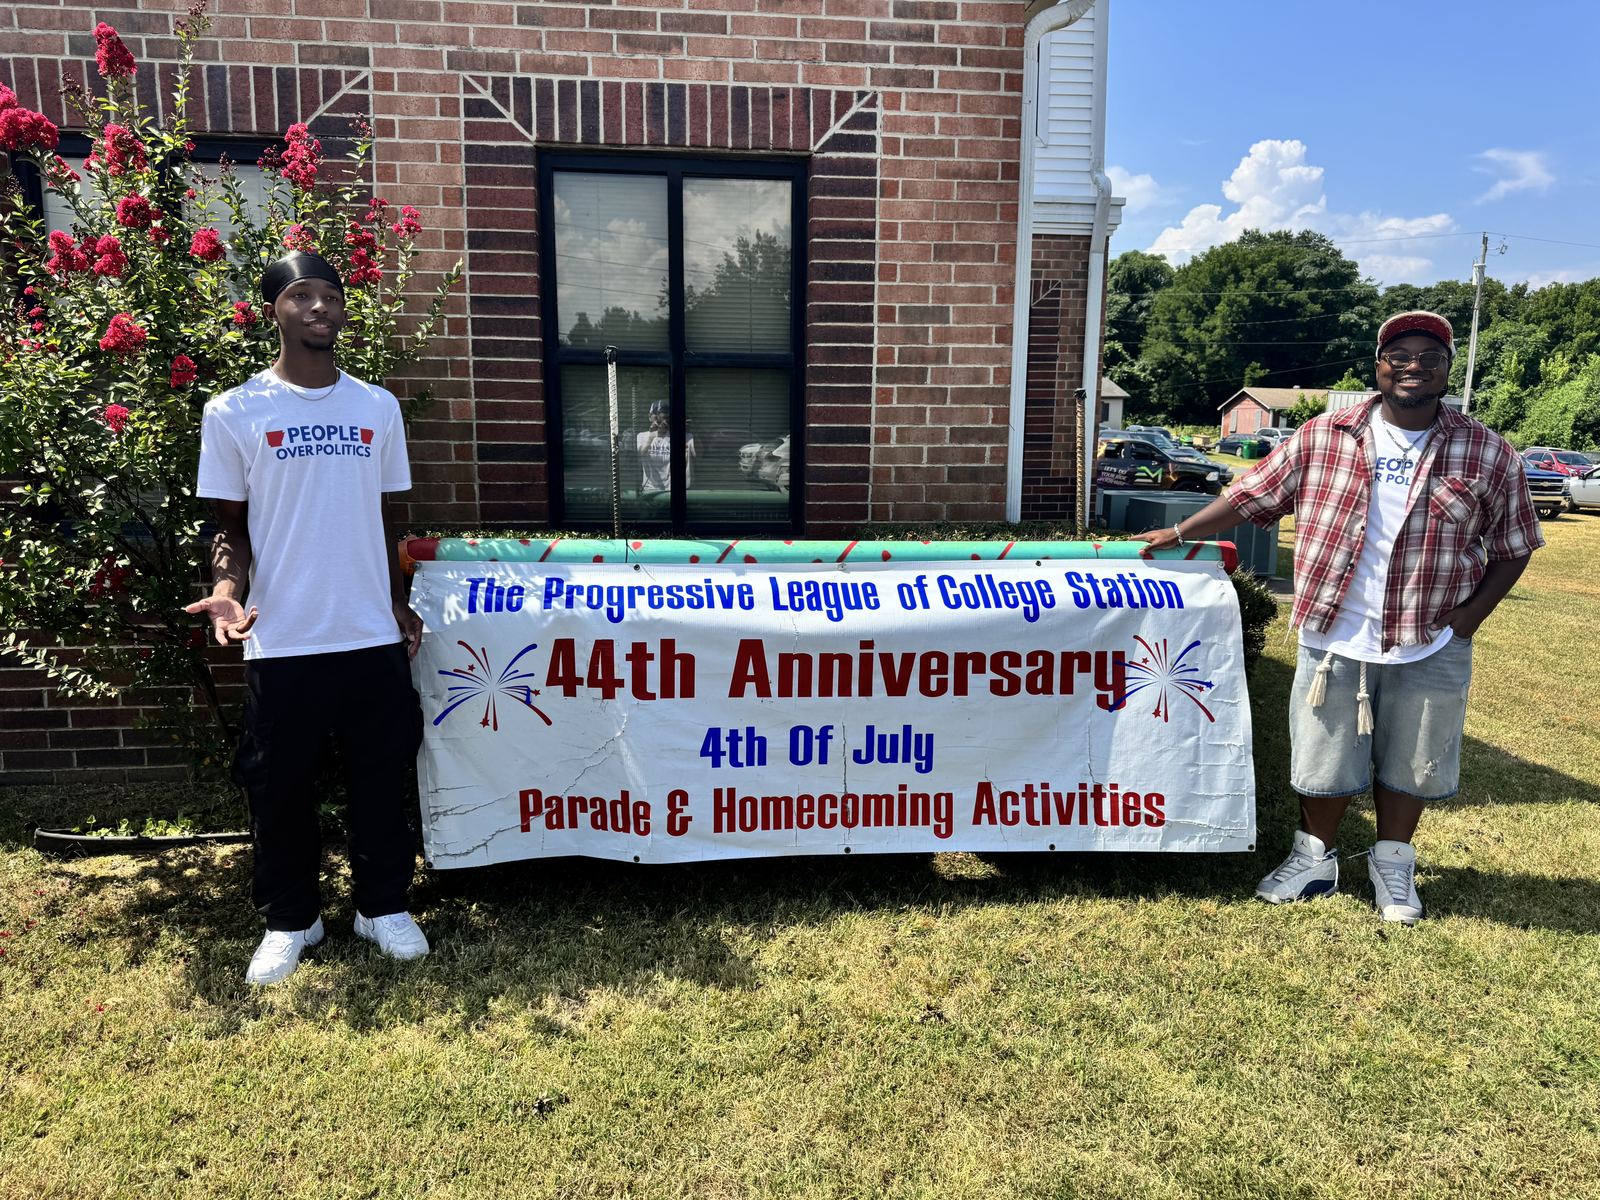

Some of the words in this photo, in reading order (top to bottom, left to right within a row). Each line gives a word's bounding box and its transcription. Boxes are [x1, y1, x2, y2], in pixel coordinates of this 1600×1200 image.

[287, 425, 359, 443] PEOPLE
[276, 444, 314, 460] OVER
[316, 444, 371, 458] POLITICS
[1376, 457, 1414, 471] EOP
[1386, 473, 1410, 486] POL
[466, 577, 525, 614] The
[543, 577, 754, 624] Progressive
[769, 576, 880, 622] League
[899, 574, 928, 610] of
[937, 574, 1056, 623] College
[1065, 571, 1185, 609] Station
[546, 638, 696, 701] 44th
[728, 638, 1126, 711] Anniversary
[700, 726, 767, 768] 4th
[789, 725, 834, 766] Of
[853, 724, 934, 774] July
[519, 788, 651, 837] Parade
[667, 789, 692, 837] &
[713, 783, 953, 839] Homecoming
[972, 781, 1166, 828] Activities
